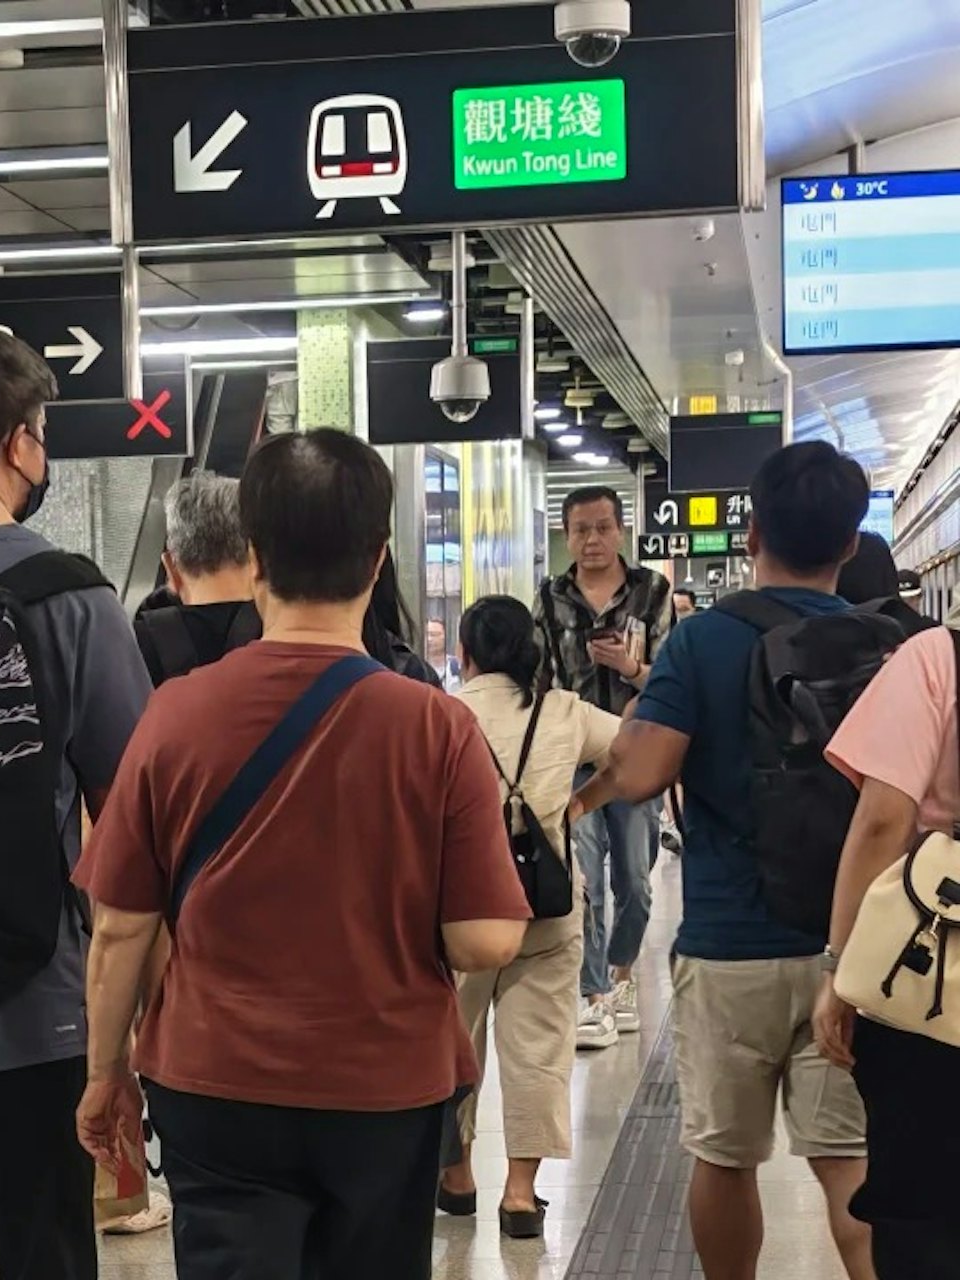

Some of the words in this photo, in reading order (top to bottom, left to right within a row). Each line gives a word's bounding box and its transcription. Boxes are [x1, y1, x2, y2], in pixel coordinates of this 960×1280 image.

[463, 91, 602, 144] 觀塘綫
[463, 154, 517, 176] Kwun
[522, 150, 571, 177] Tong
[575, 147, 618, 170] Line
